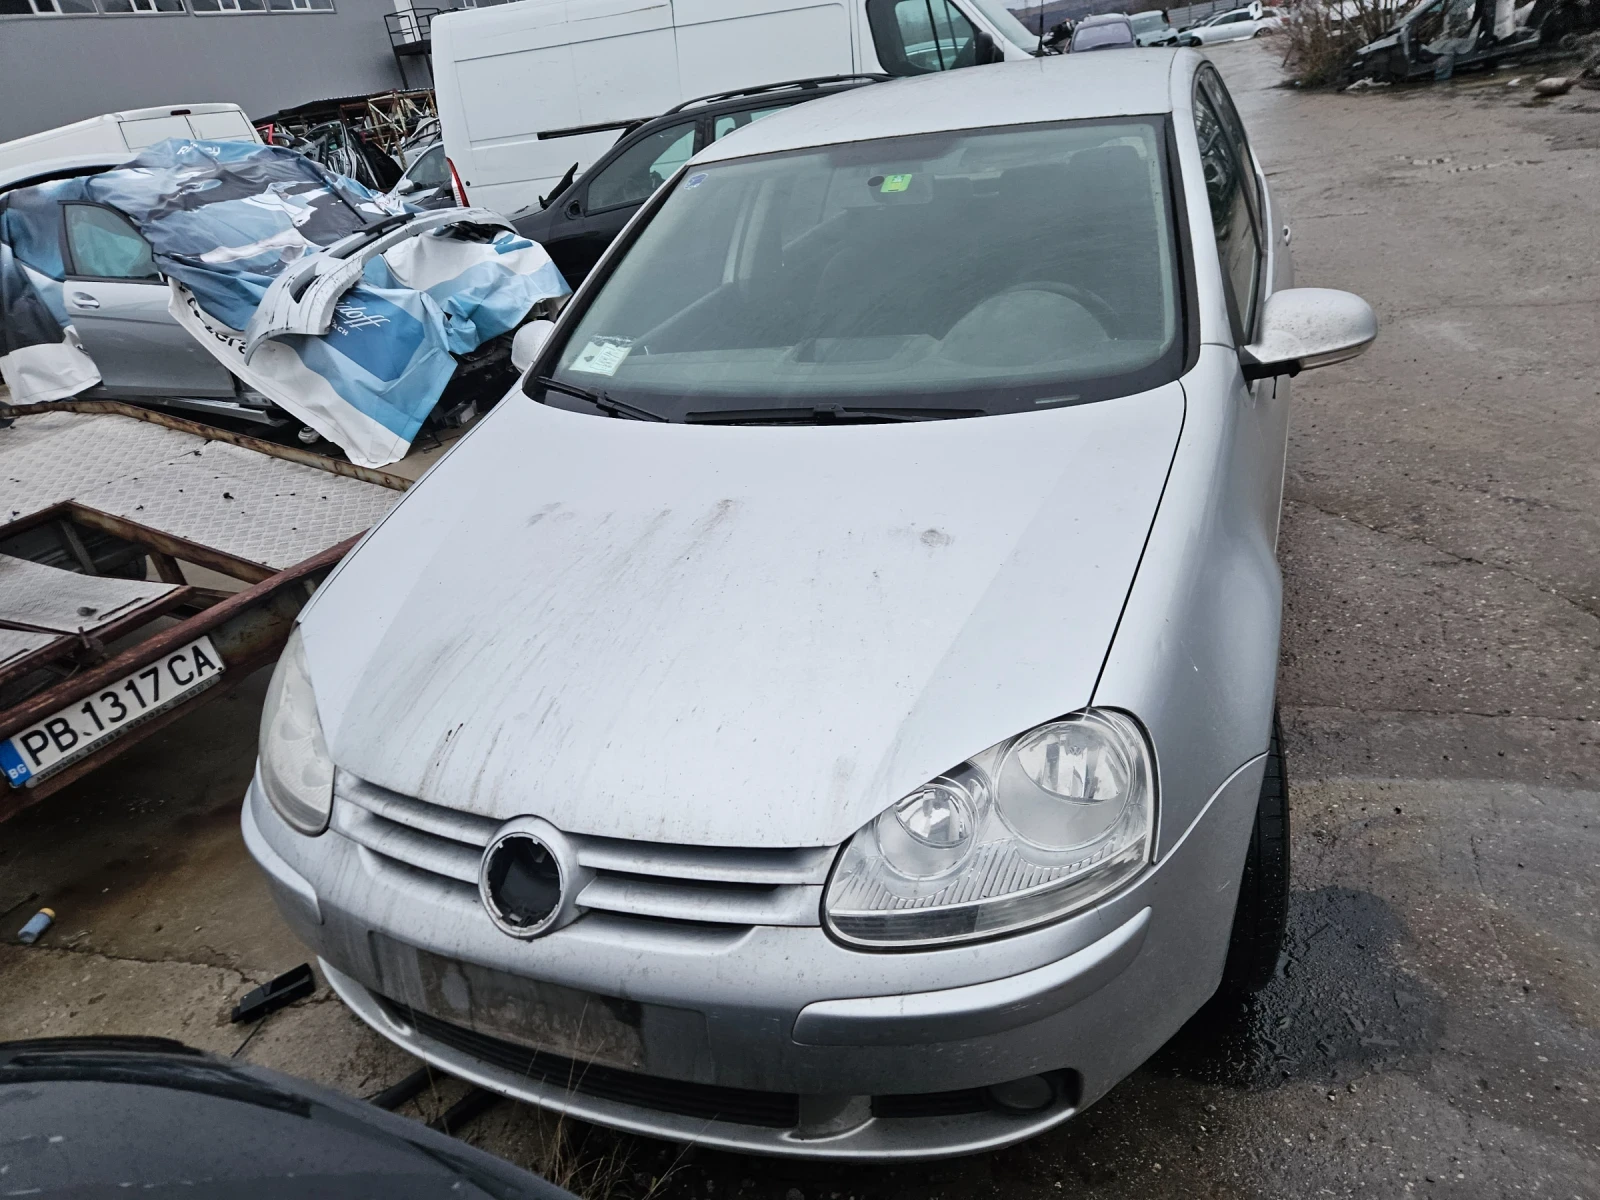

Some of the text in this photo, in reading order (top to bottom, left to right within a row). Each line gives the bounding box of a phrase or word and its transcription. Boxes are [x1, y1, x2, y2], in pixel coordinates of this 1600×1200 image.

[20, 717, 79, 767] PB
[81, 667, 160, 731] 1317
[167, 645, 217, 686] CA
[8, 763, 27, 779] BG
